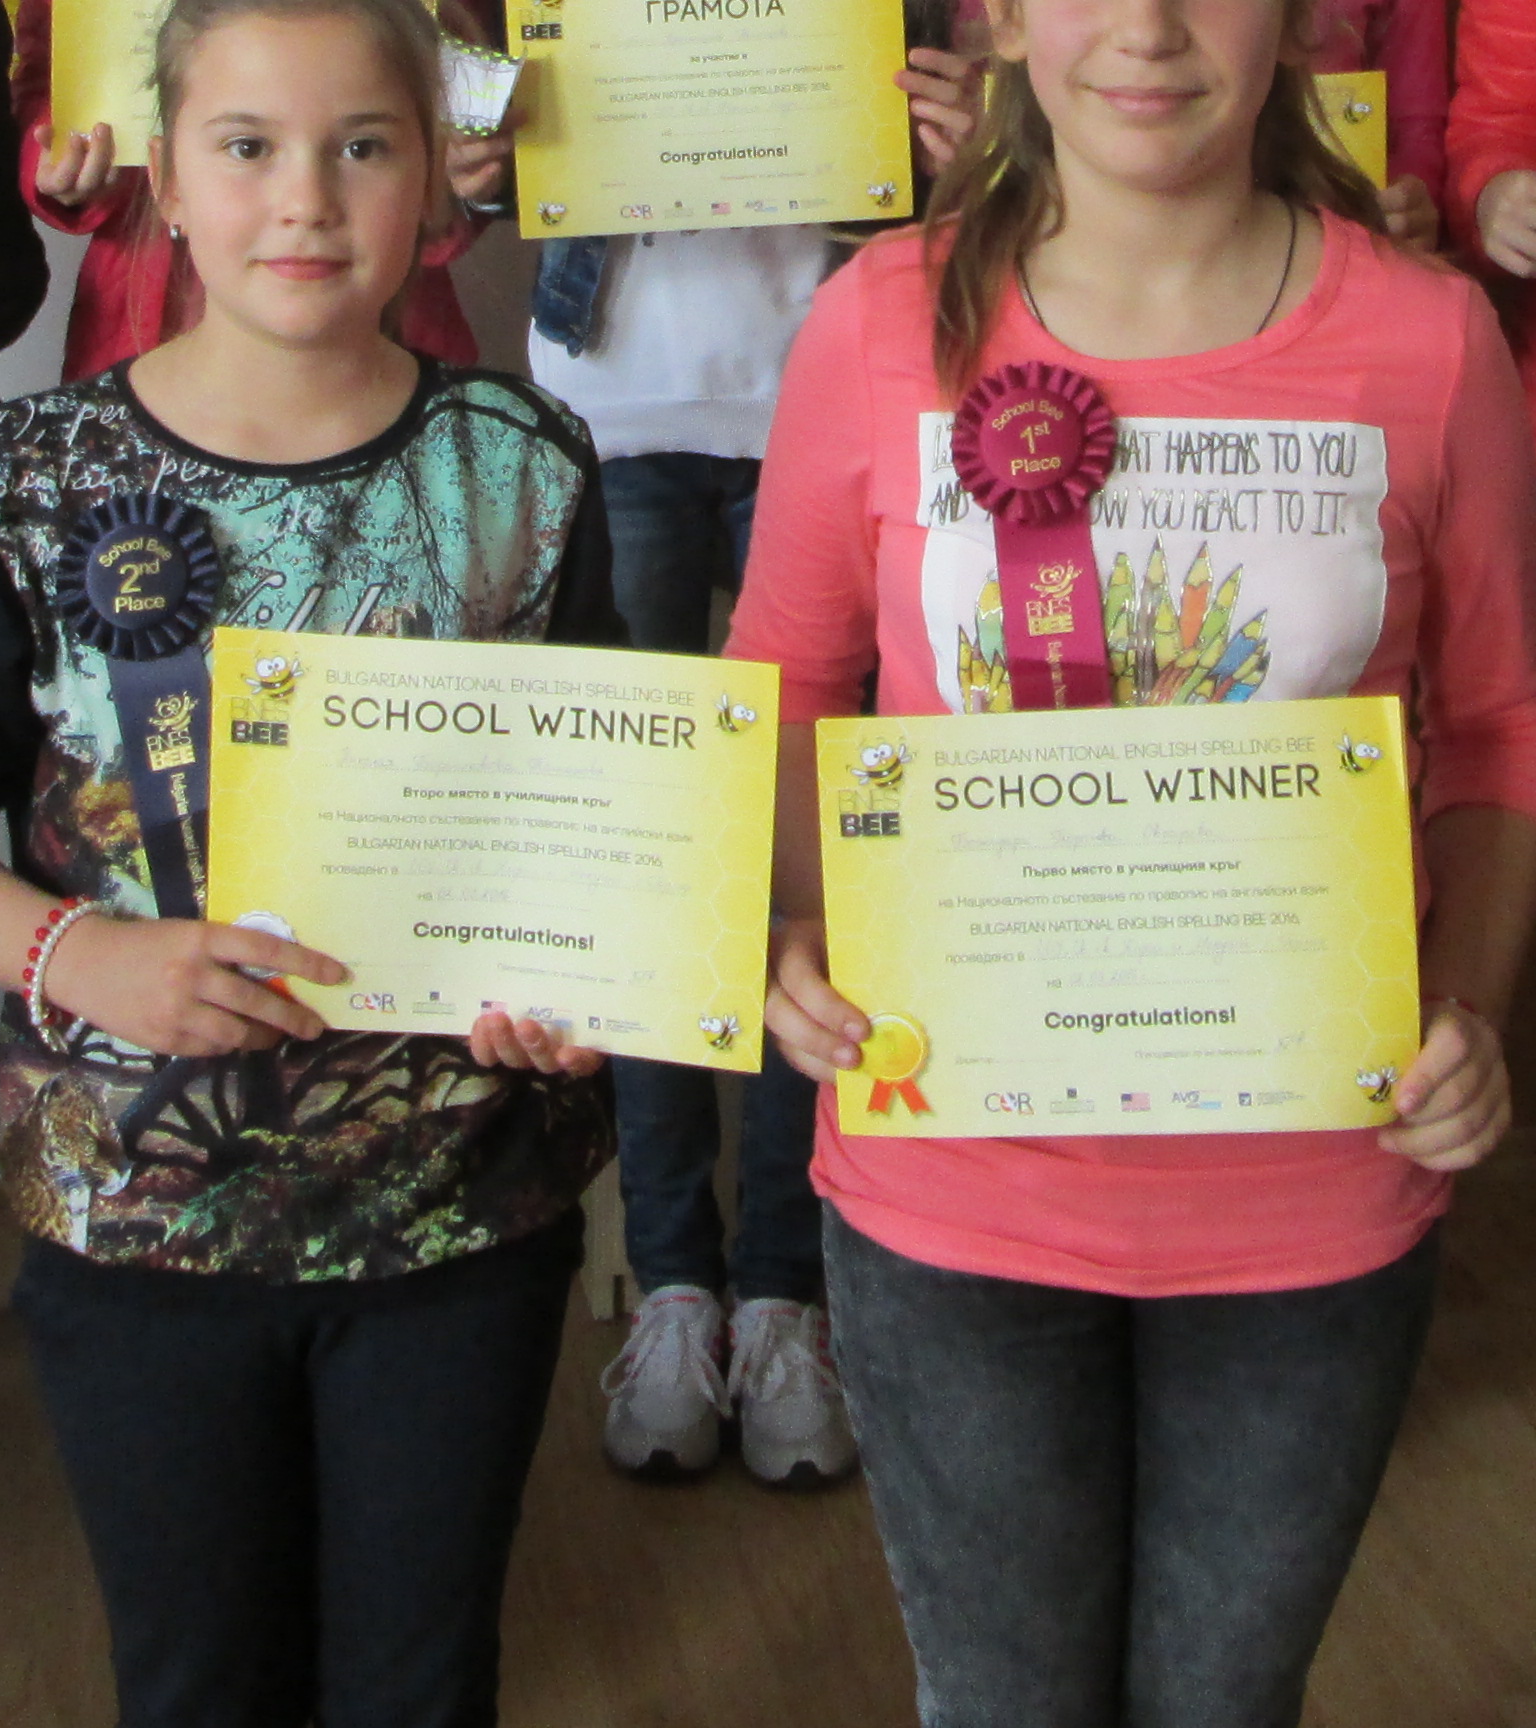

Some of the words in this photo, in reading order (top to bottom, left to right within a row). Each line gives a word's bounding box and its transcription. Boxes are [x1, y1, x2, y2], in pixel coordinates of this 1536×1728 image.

[520, 23, 563, 41] BEE
[659, 144, 789, 165] Congratulations!
[991, 398, 1035, 432] School
[1020, 421, 1051, 455] 1st
[1010, 455, 1062, 476] Place
[1165, 429, 1261, 474] HAPPENS
[1268, 431, 1302, 474] TO
[1310, 432, 1357, 478] YOU
[1140, 487, 1185, 532] YOU
[1192, 488, 1265, 532] REACT
[1275, 490, 1306, 534] TO
[98, 537, 143, 567] School
[119, 558, 160, 594] 2nd
[114, 596, 166, 613] Place
[325, 669, 419, 689] BULGARIAN
[423, 672, 506, 692] NATIONAL
[511, 677, 581, 696] ENGLISH
[585, 682, 664, 704] SPELLING
[667, 690, 695, 707] BEE
[231, 720, 289, 746] BEE
[323, 694, 511, 735] SCHOOL
[527, 703, 697, 750] WINNER
[934, 748, 1032, 767] BULGARIAN
[1034, 745, 1119, 762] NATIONAL
[1124, 741, 1198, 759] ENGLISH
[1201, 738, 1282, 756] SPELLING
[1286, 736, 1316, 753] BEE
[402, 787, 445, 800] Второ
[448, 788, 490, 800] място
[493, 790, 501, 800] в
[504, 789, 579, 806] училищния
[838, 788, 900, 813] BNES
[934, 770, 1129, 811] SCHOOL
[1143, 763, 1322, 804] WINNER
[839, 811, 901, 838] BEE
[347, 836, 421, 851] BULGARIAN
[423, 837, 488, 852] NATIONAL
[491, 839, 545, 855] ENGLISH
[547, 843, 608, 861] SPELLING
[610, 850, 631, 864] BEE
[1022, 864, 1067, 879] Първо
[1070, 864, 1113, 876] място
[1117, 863, 1125, 874] в
[1128, 859, 1206, 876] училищния
[412, 921, 595, 952] Congratulations!
[970, 922, 1046, 936] BULGARIAN
[1048, 918, 1114, 933] NATIONAL
[1117, 915, 1175, 931] ENGLISH
[1177, 913, 1240, 929] SPELLING
[1242, 912, 1266, 926] BEE
[1043, 1005, 1237, 1034] Congratulations!
